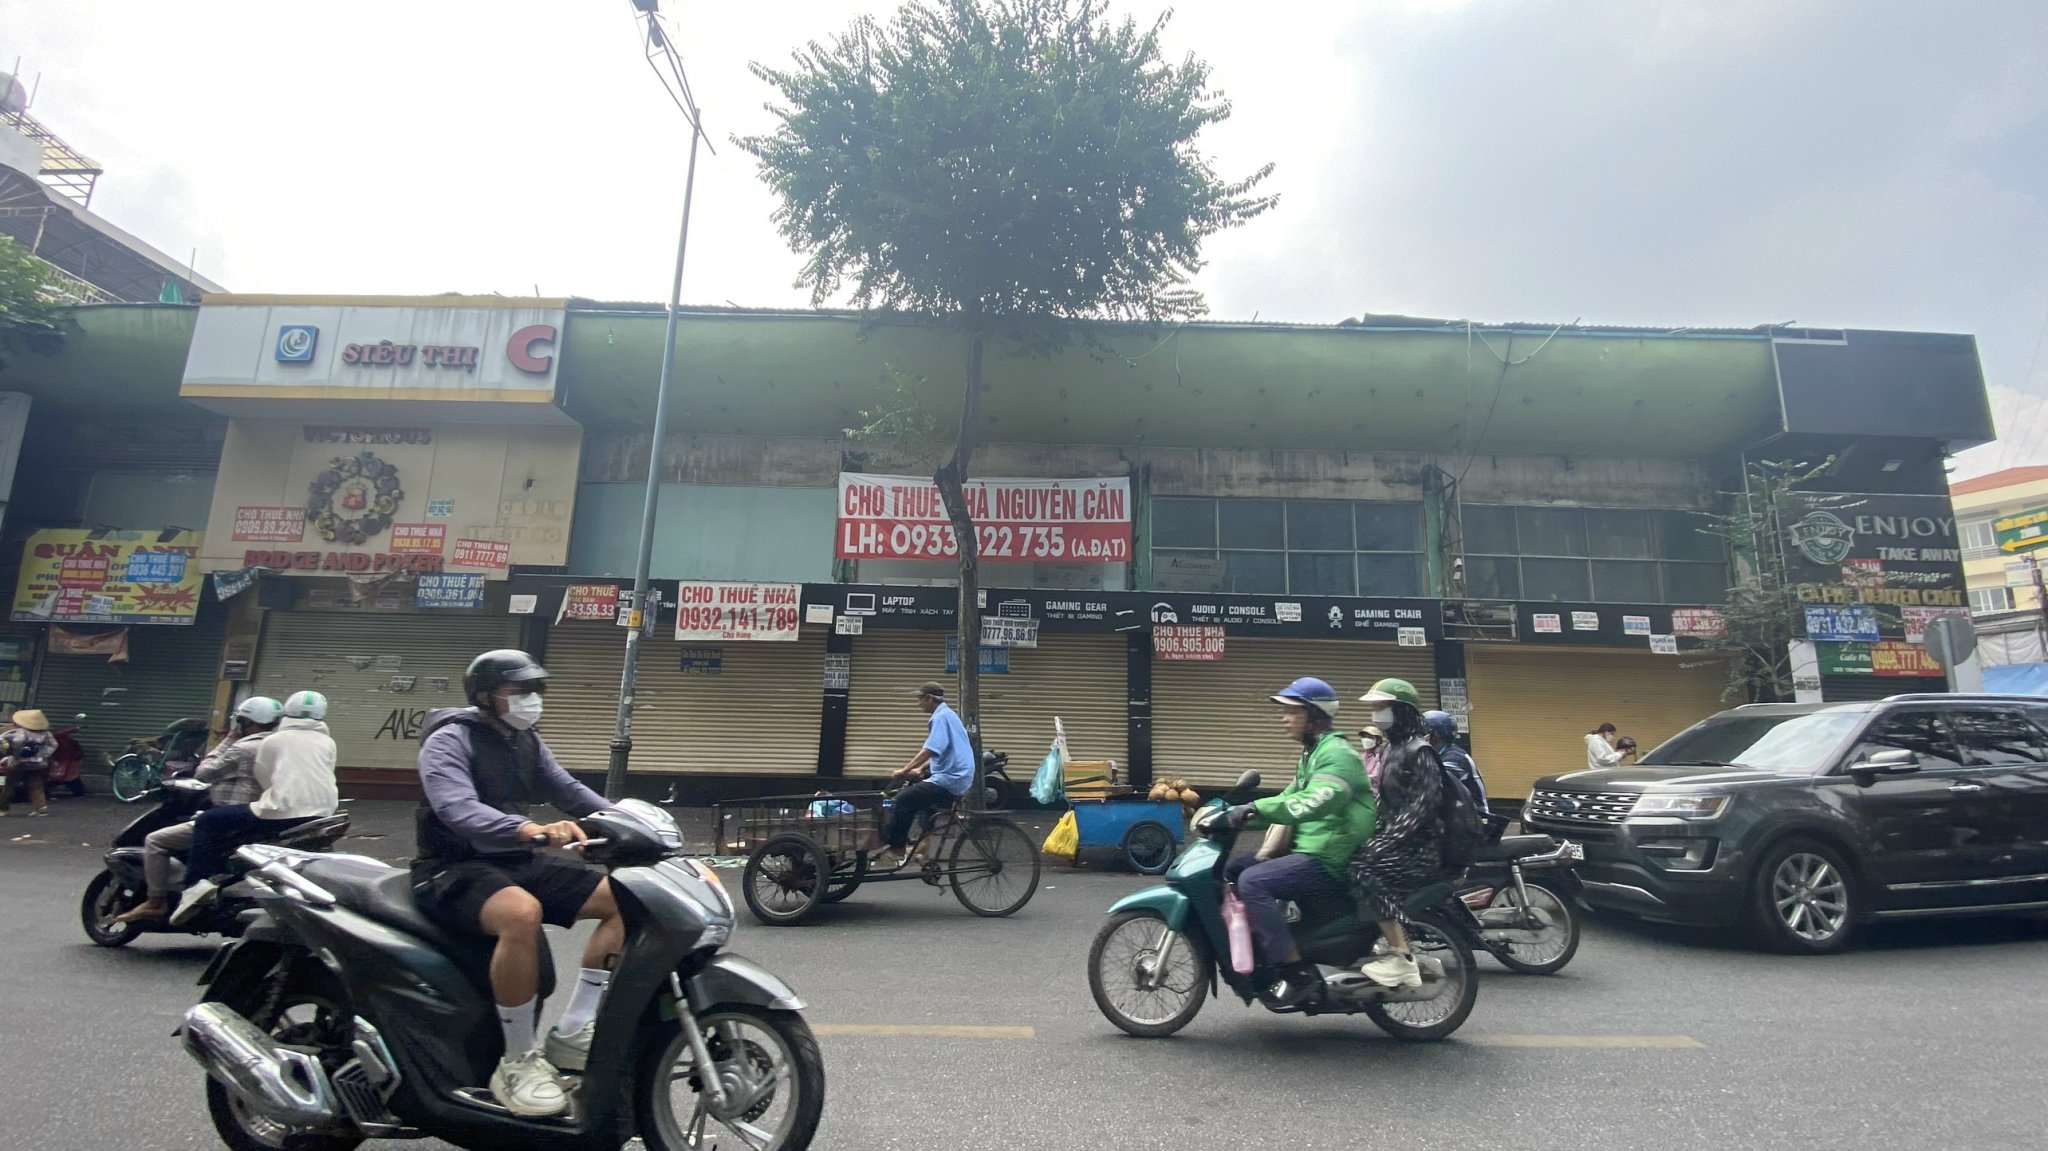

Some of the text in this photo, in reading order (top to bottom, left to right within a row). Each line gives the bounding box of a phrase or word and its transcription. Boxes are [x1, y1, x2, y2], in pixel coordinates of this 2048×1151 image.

[343, 338, 479, 373] SIÊU THỊ
[506, 323, 557, 374] C
[845, 484, 885, 517] CHO
[891, 481, 941, 518] THUÊ
[995, 482, 1077, 521] NGUYÊN
[1083, 482, 1124, 521] CĂN
[1855, 515, 1953, 540] ENJOY
[457, 540, 472, 549] CHO
[844, 522, 884, 555] LH:
[1019, 526, 1065, 558] 735
[454, 548, 473, 560] 0911
[476, 551, 496, 562] 7777
[1876, 547, 1961, 562] TAKE AWAY
[322, 552, 371, 571] AND
[373, 553, 444, 573] POKER
[419, 575, 440, 588] CHO
[441, 574, 467, 588] THUÊ
[568, 586, 589, 597] CHO
[591, 584, 616, 597] THUÊ
[681, 584, 797, 605] CHO THUÊ NHÀ
[882, 596, 915, 606] LAPTOP
[1045, 600, 1107, 612] GAMING GEAR
[1191, 604, 1216, 614] AUDIO
[1228, 606, 1266, 616] CONSOLE
[1354, 609, 1422, 619] GAMING CHAIR
[1903, 609, 1922, 617] CHO
[679, 606, 798, 632] 0932.141.789
[982, 626, 1037, 642] 0777.96.86.87
[1153, 626, 1173, 637] CHO
[1153, 637, 1225, 653] 0906.905.006
